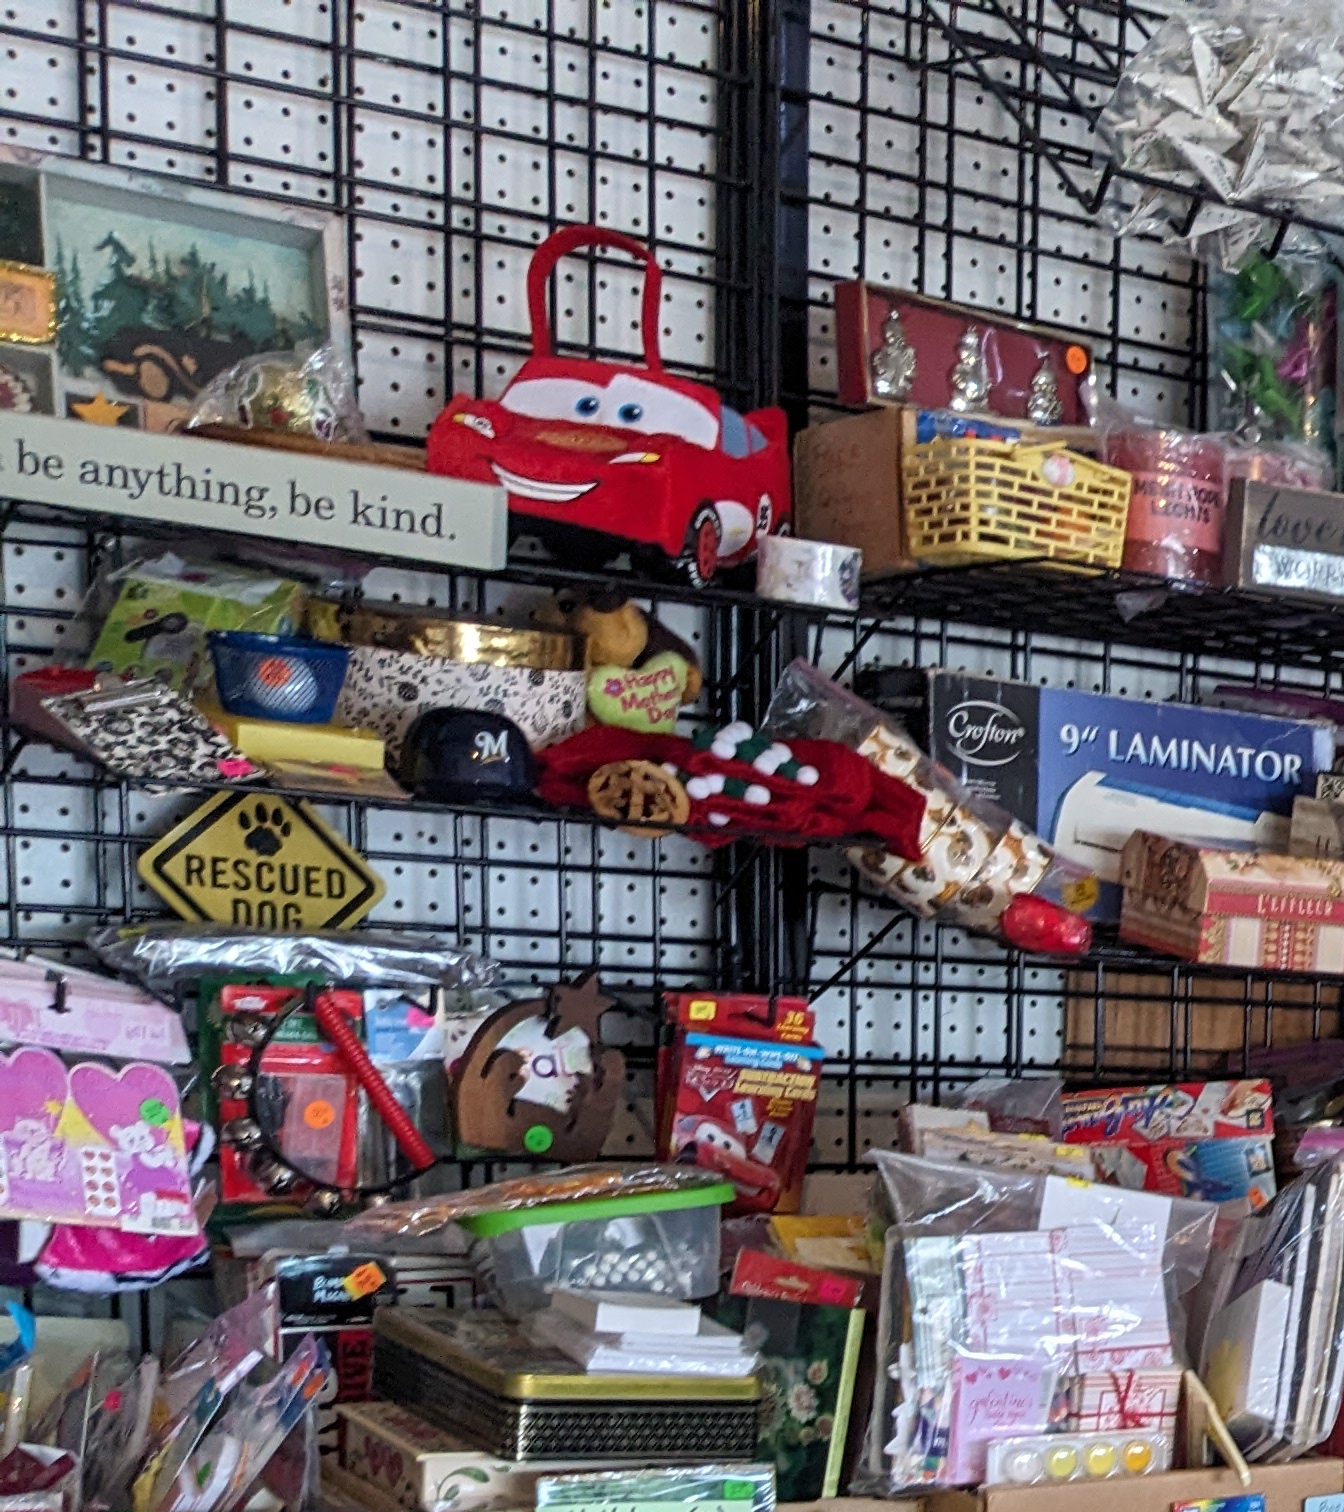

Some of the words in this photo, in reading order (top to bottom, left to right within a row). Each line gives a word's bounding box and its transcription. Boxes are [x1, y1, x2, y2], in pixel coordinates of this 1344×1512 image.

[15, 438, 65, 478] be
[79, 457, 279, 520] anything,
[287, 479, 337, 520] be
[350, 489, 458, 541] kind.
[474, 730, 510, 763] M
[949, 710, 1020, 755] Crofton
[1108, 731, 1302, 784] LAMINATOR
[184, 855, 347, 900] RESCUED
[231, 898, 303, 930] DOG
